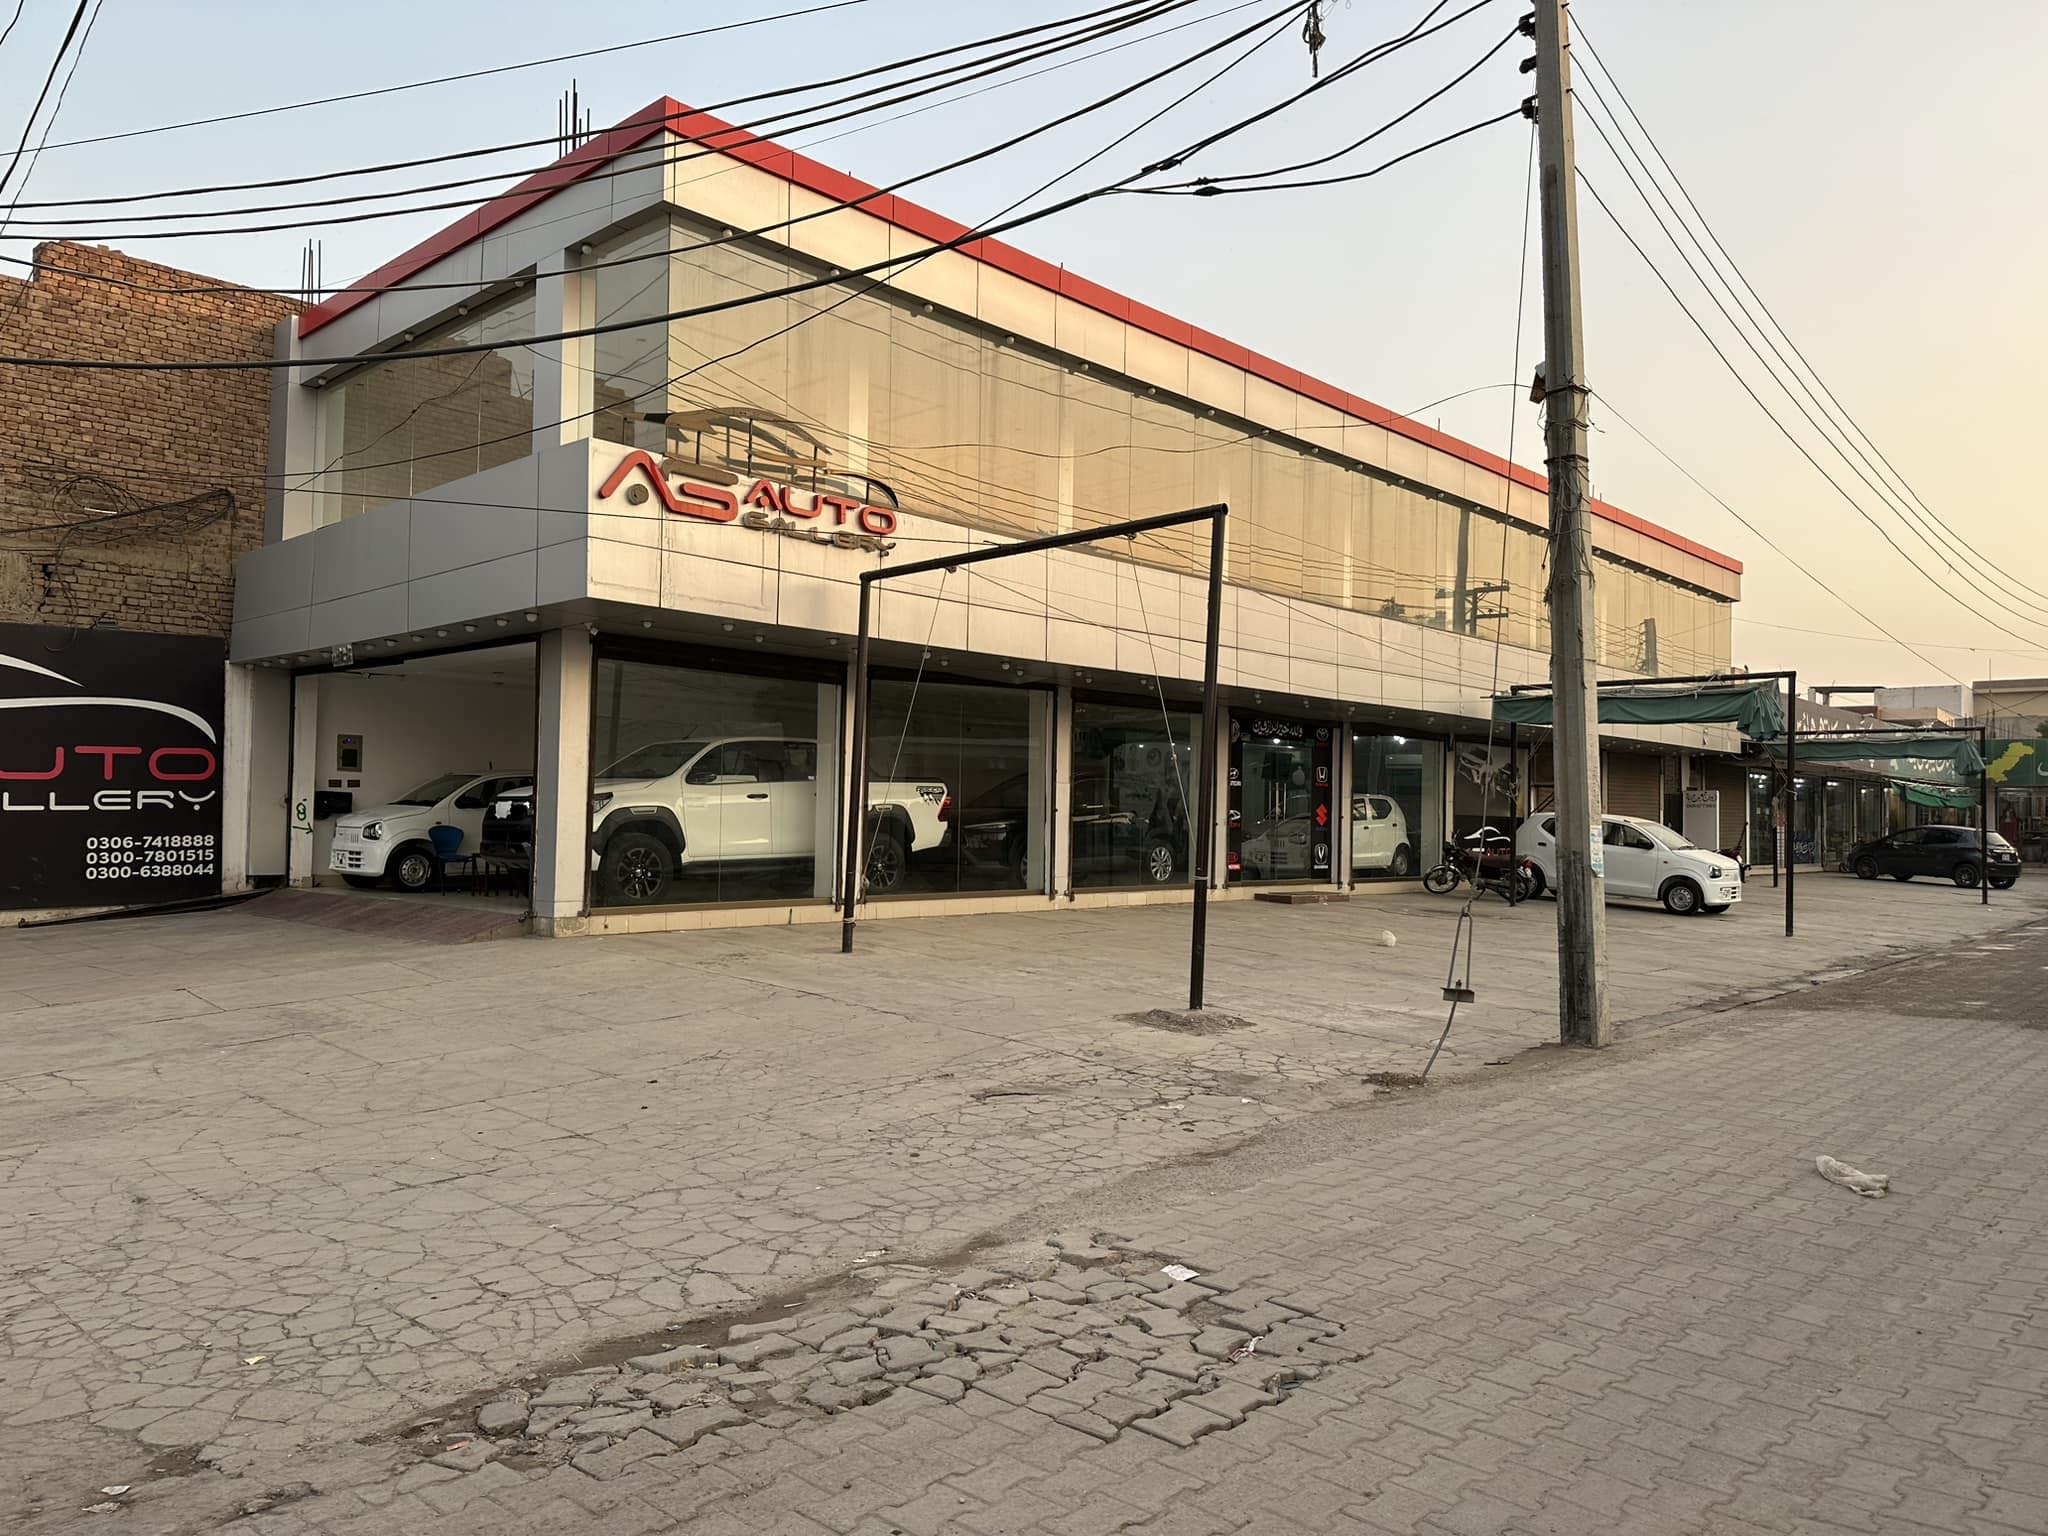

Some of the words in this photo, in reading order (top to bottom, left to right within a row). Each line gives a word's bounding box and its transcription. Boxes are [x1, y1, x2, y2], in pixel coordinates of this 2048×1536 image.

[599, 450, 739, 522] AS
[744, 479, 897, 535] AUTO
[86, 834, 215, 849] 0306-7418888
[85, 849, 214, 864] 0300-7801515
[85, 863, 214, 879] 0300-6388044
